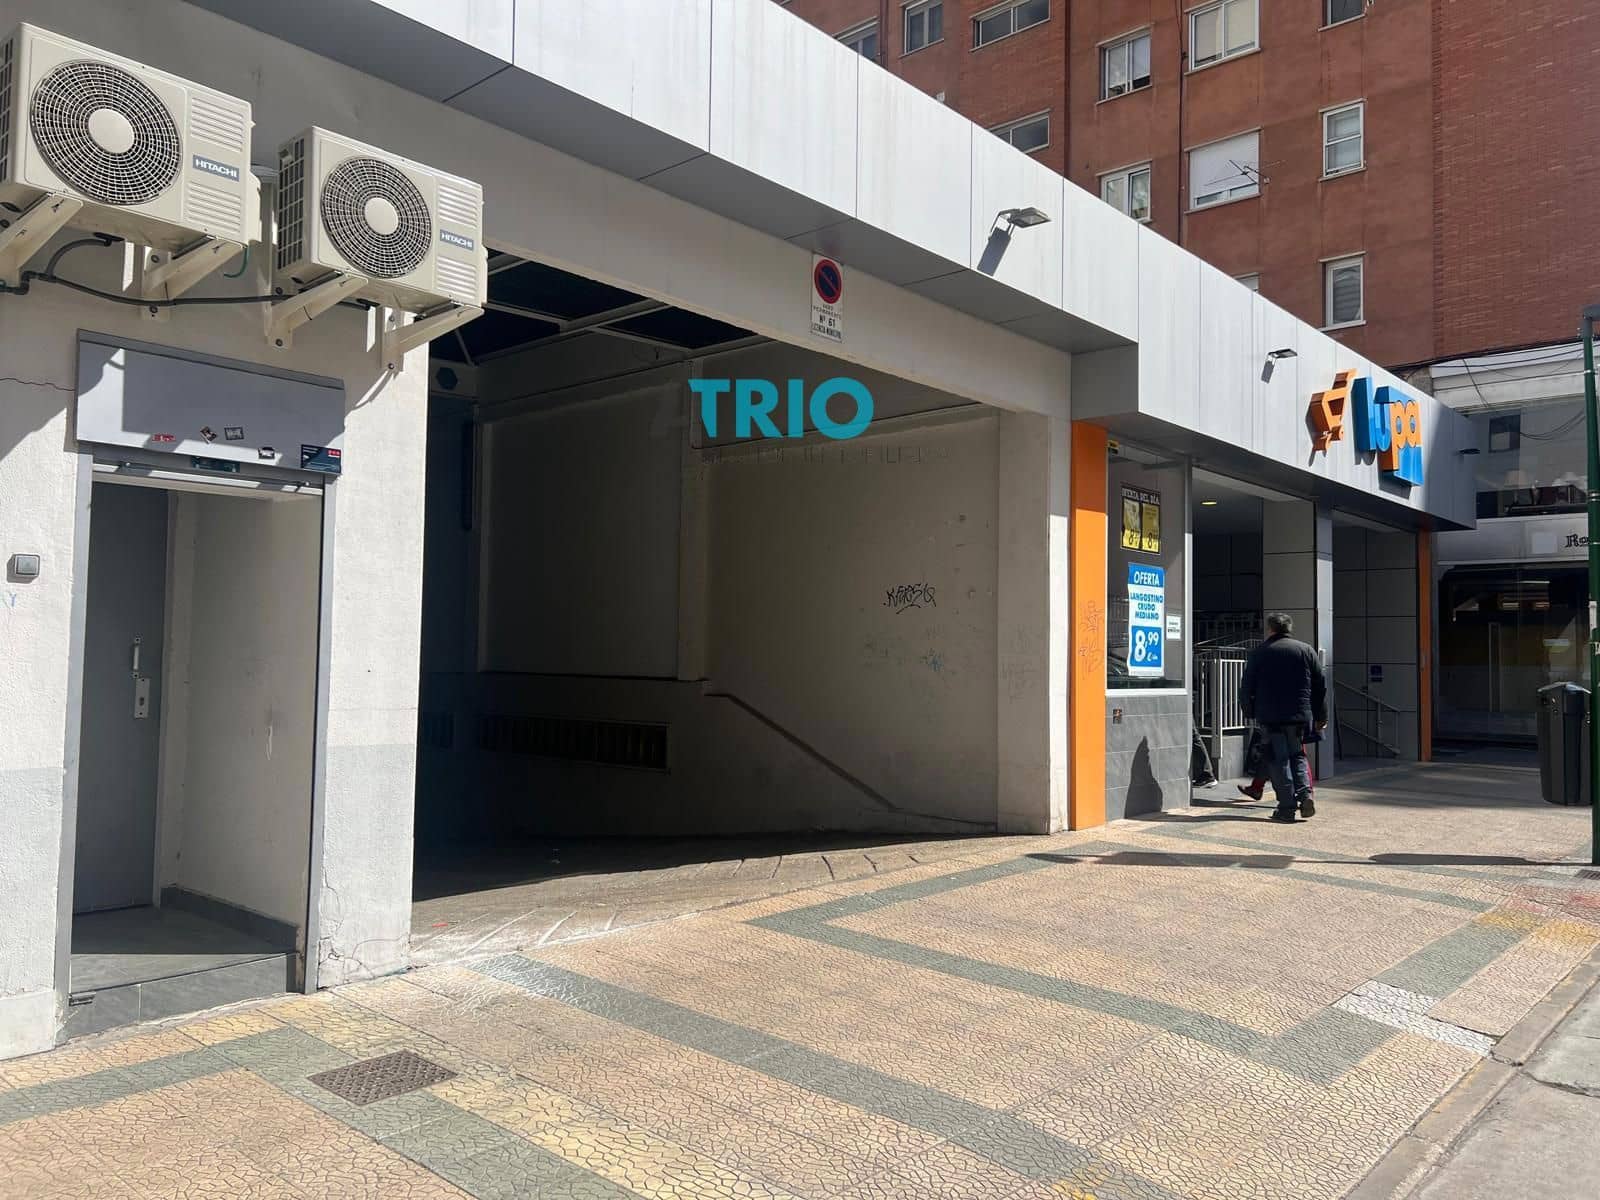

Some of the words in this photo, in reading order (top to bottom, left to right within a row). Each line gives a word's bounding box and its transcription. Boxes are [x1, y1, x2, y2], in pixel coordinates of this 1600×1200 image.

[194, 158, 238, 178] HITACHI
[441, 232, 473, 248] HITACHI
[828, 318, 836, 328] 61
[1351, 376, 1423, 473] lupa
[1133, 570, 1160, 586] OFERTA
[1130, 592, 1163, 604] LANGOSTINO
[1137, 602, 1156, 612] CRUDO
[1135, 611, 1159, 621] MEDIANO
[1134, 630, 1159, 662] 8,99
